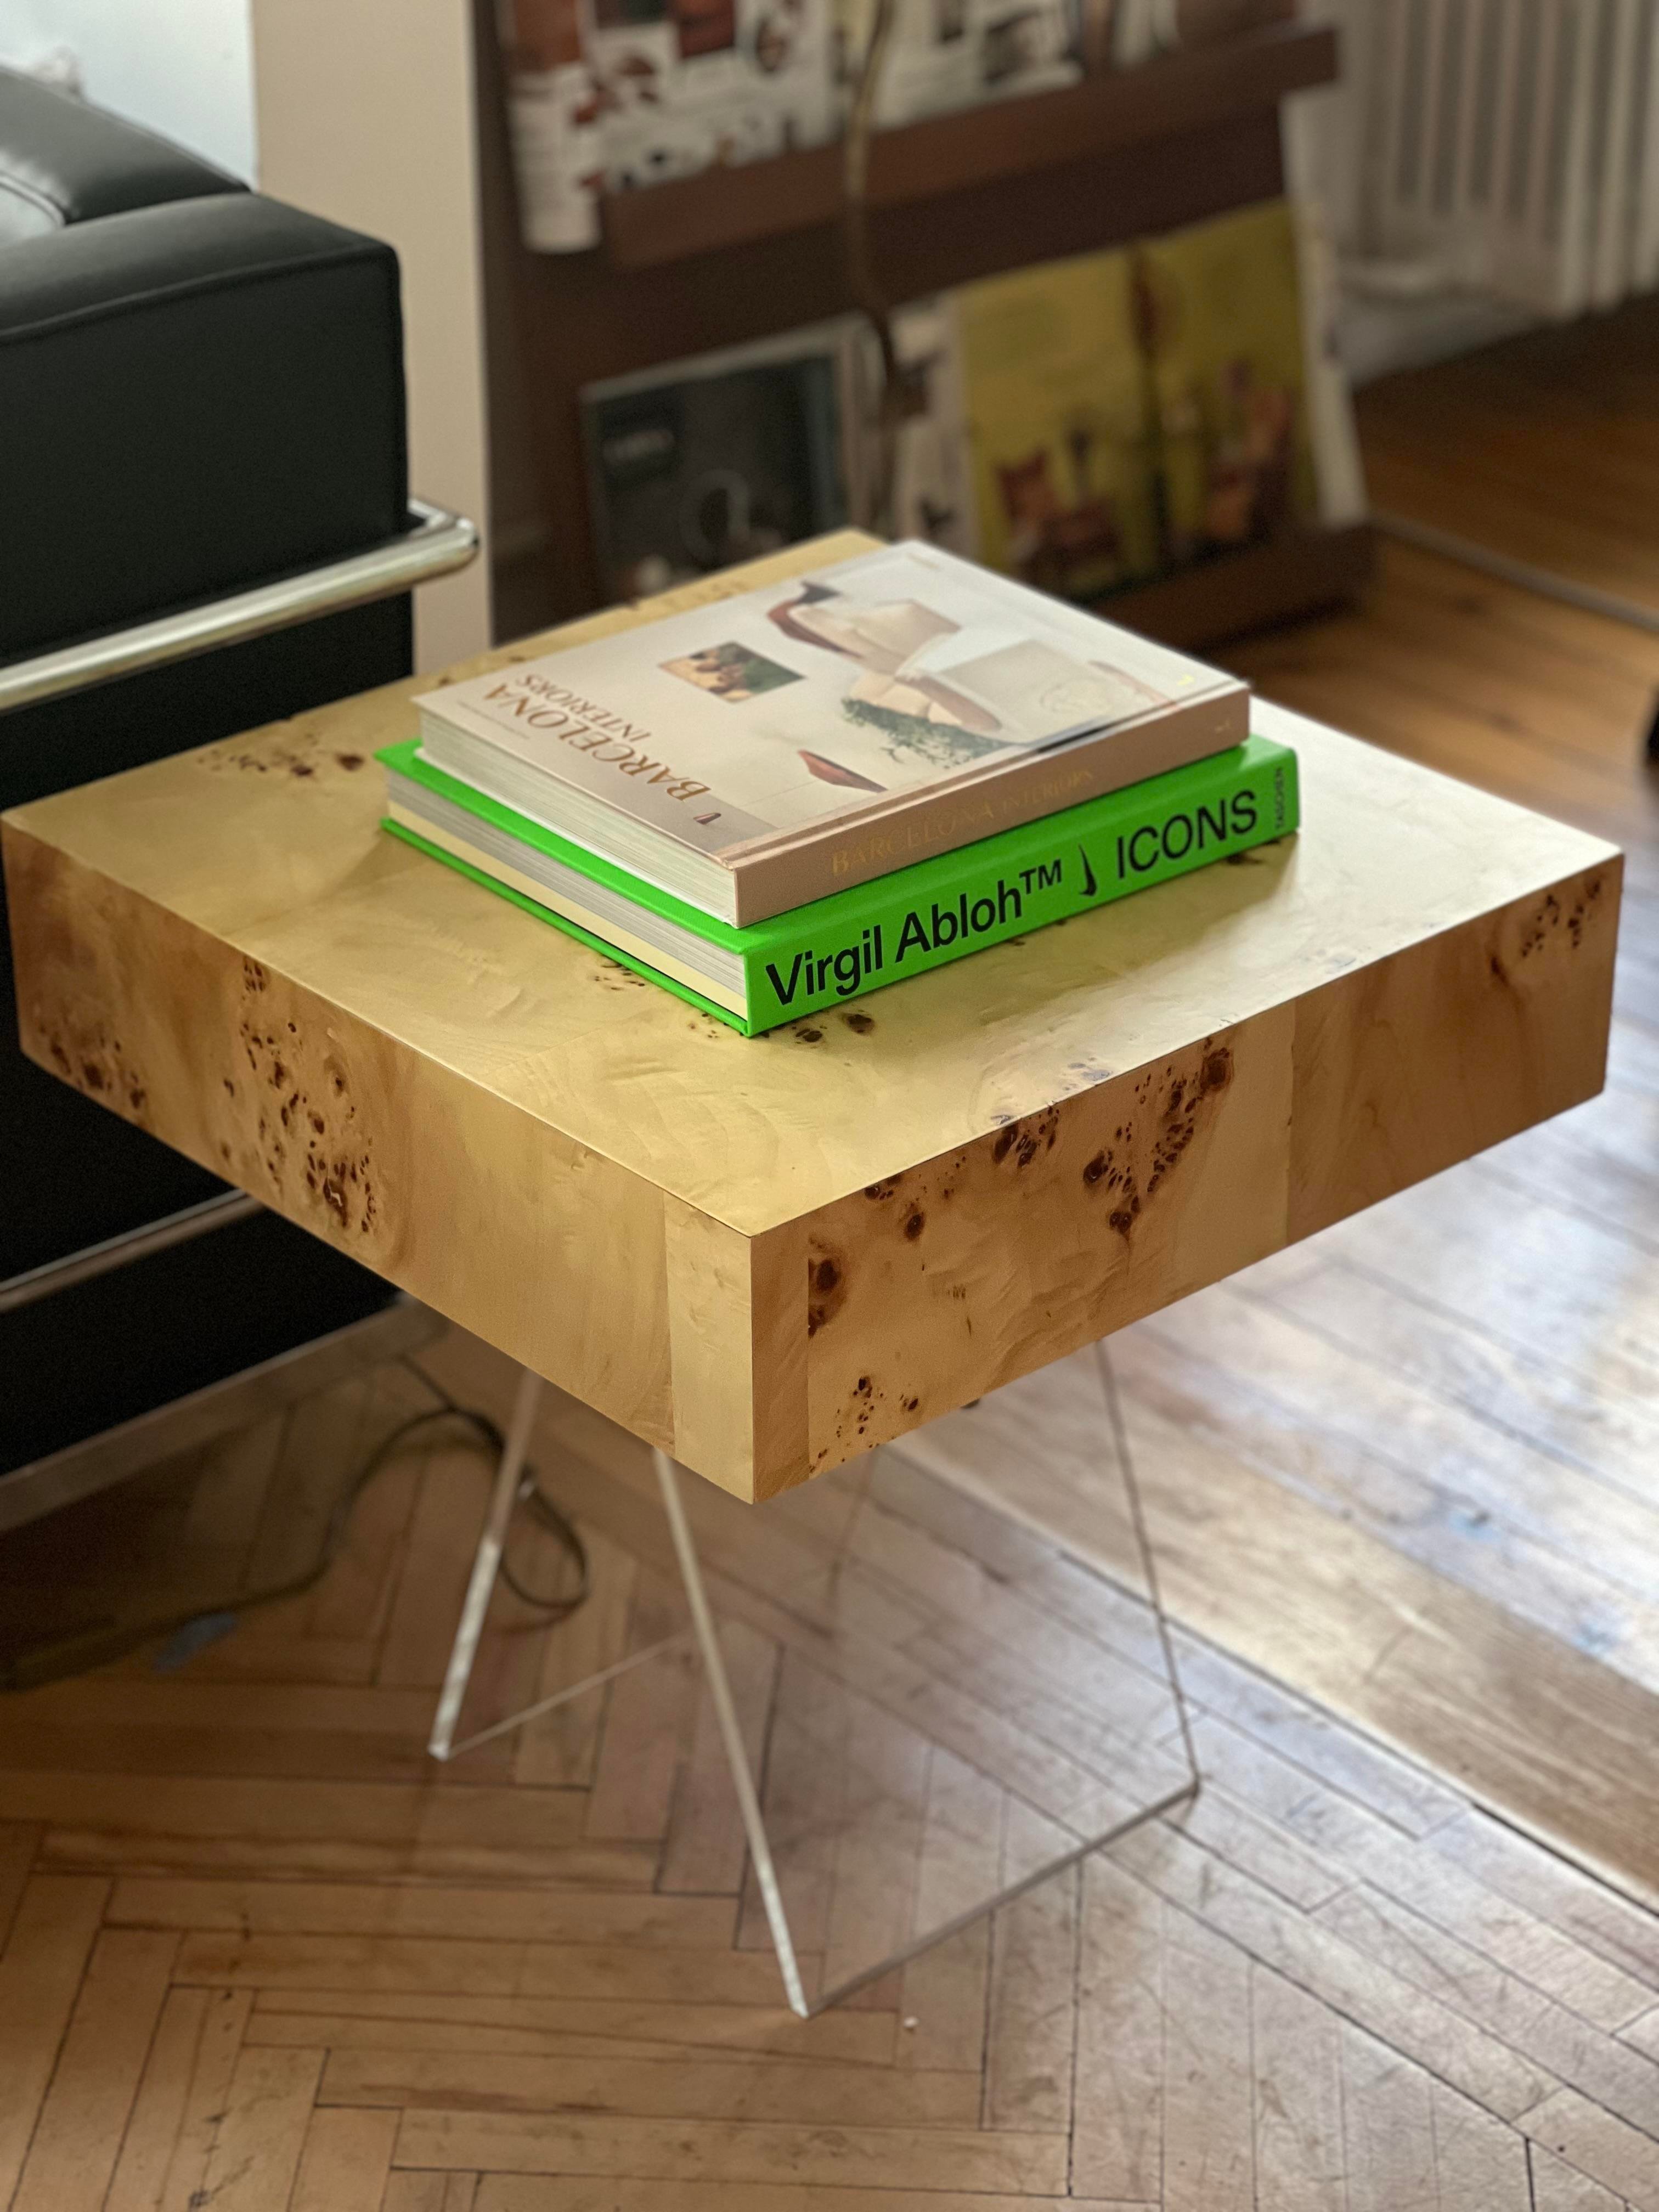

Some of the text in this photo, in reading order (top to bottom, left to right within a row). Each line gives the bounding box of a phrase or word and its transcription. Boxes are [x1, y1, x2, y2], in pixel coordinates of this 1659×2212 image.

[483, 682, 712, 803] BARCELONA
[516, 673, 652, 743] INTERIORS
[832, 802, 995, 877] BARCELONA
[765, 924, 883, 1006] Virgil
[1117, 789, 1257, 879] ICONS
